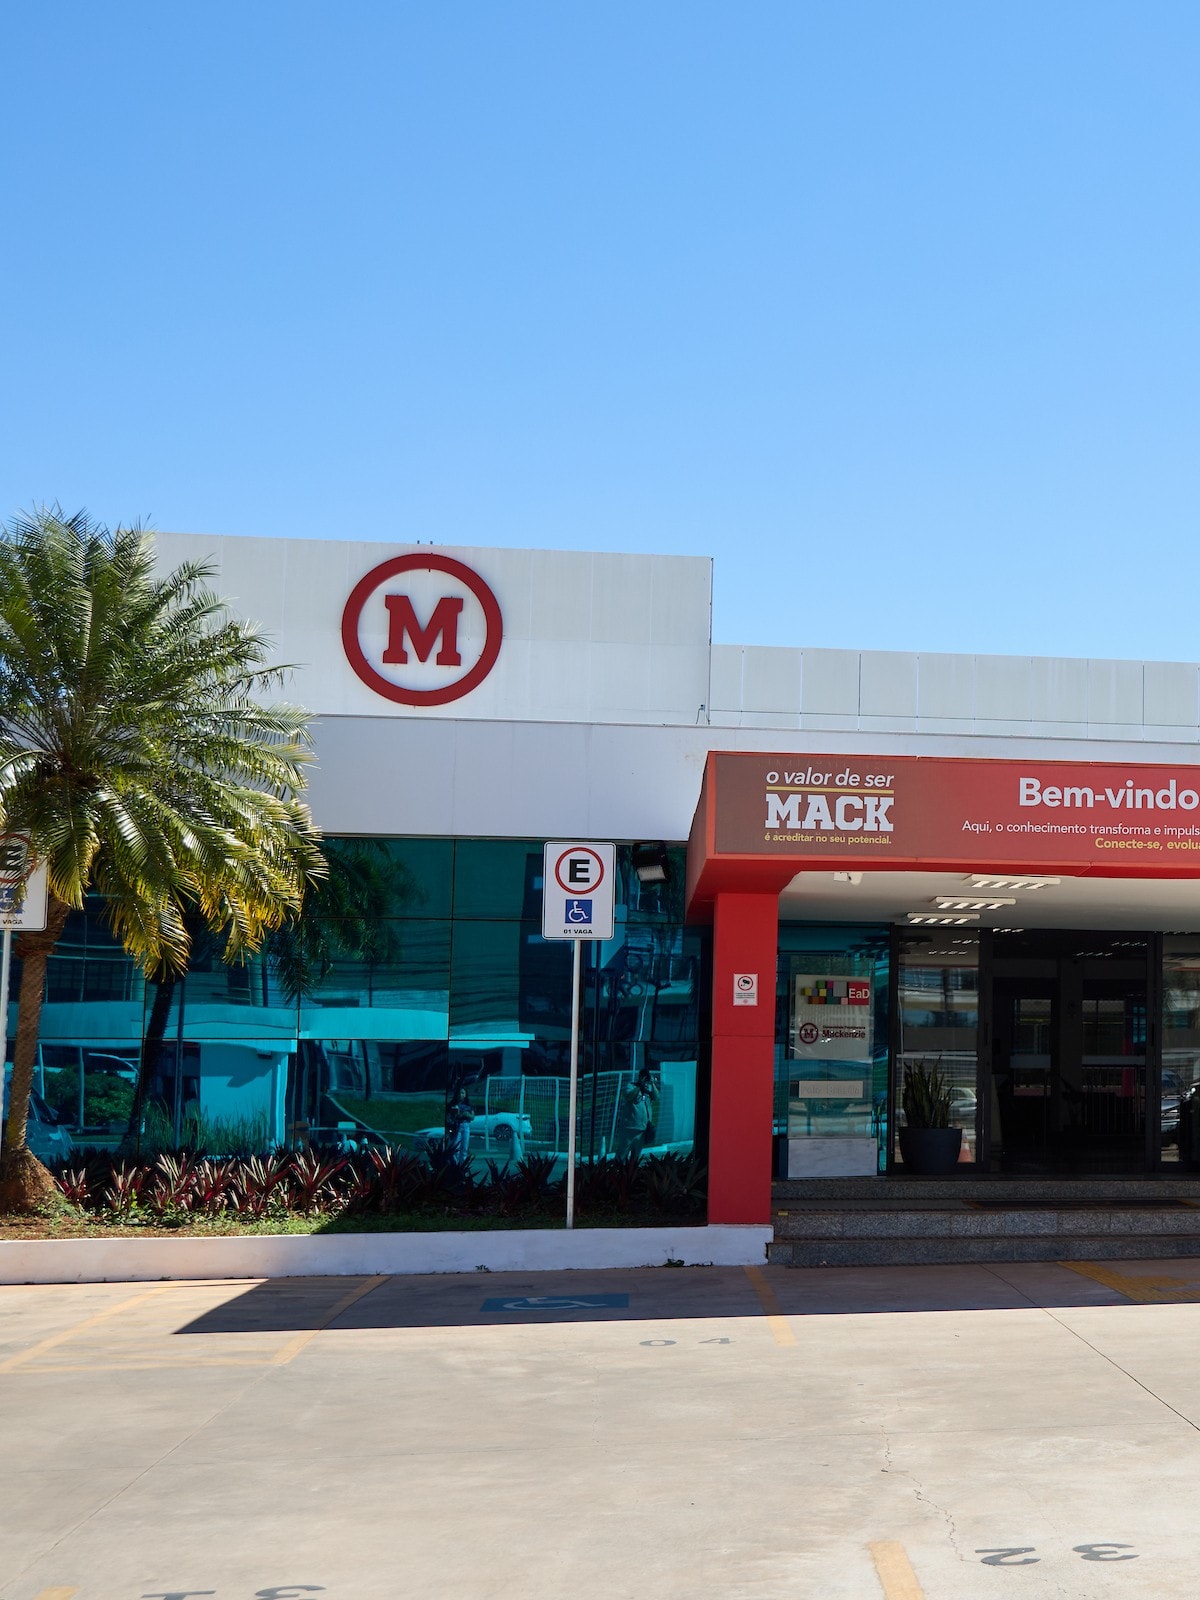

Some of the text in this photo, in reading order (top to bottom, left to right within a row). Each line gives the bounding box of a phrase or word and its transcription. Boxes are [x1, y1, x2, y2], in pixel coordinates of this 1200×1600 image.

[382, 594, 464, 667] M
[766, 767, 894, 787] o valor de ser
[1019, 777, 1200, 810] Bem-vindo
[765, 793, 895, 832] MACK
[962, 820, 993, 835] Aqui,
[996, 823, 1004, 832] o
[1006, 821, 1087, 834] conhecimento
[1089, 823, 1151, 836] transforma
[1154, 827, 1161, 835] e
[765, 832, 892, 846] é acreditar no seu potencial.
[1095, 837, 1163, 851] Conecte-se,
[569, 859, 590, 883] E
[849, 988, 870, 999] EaD
[822, 1029, 866, 1039] Mackenzie
